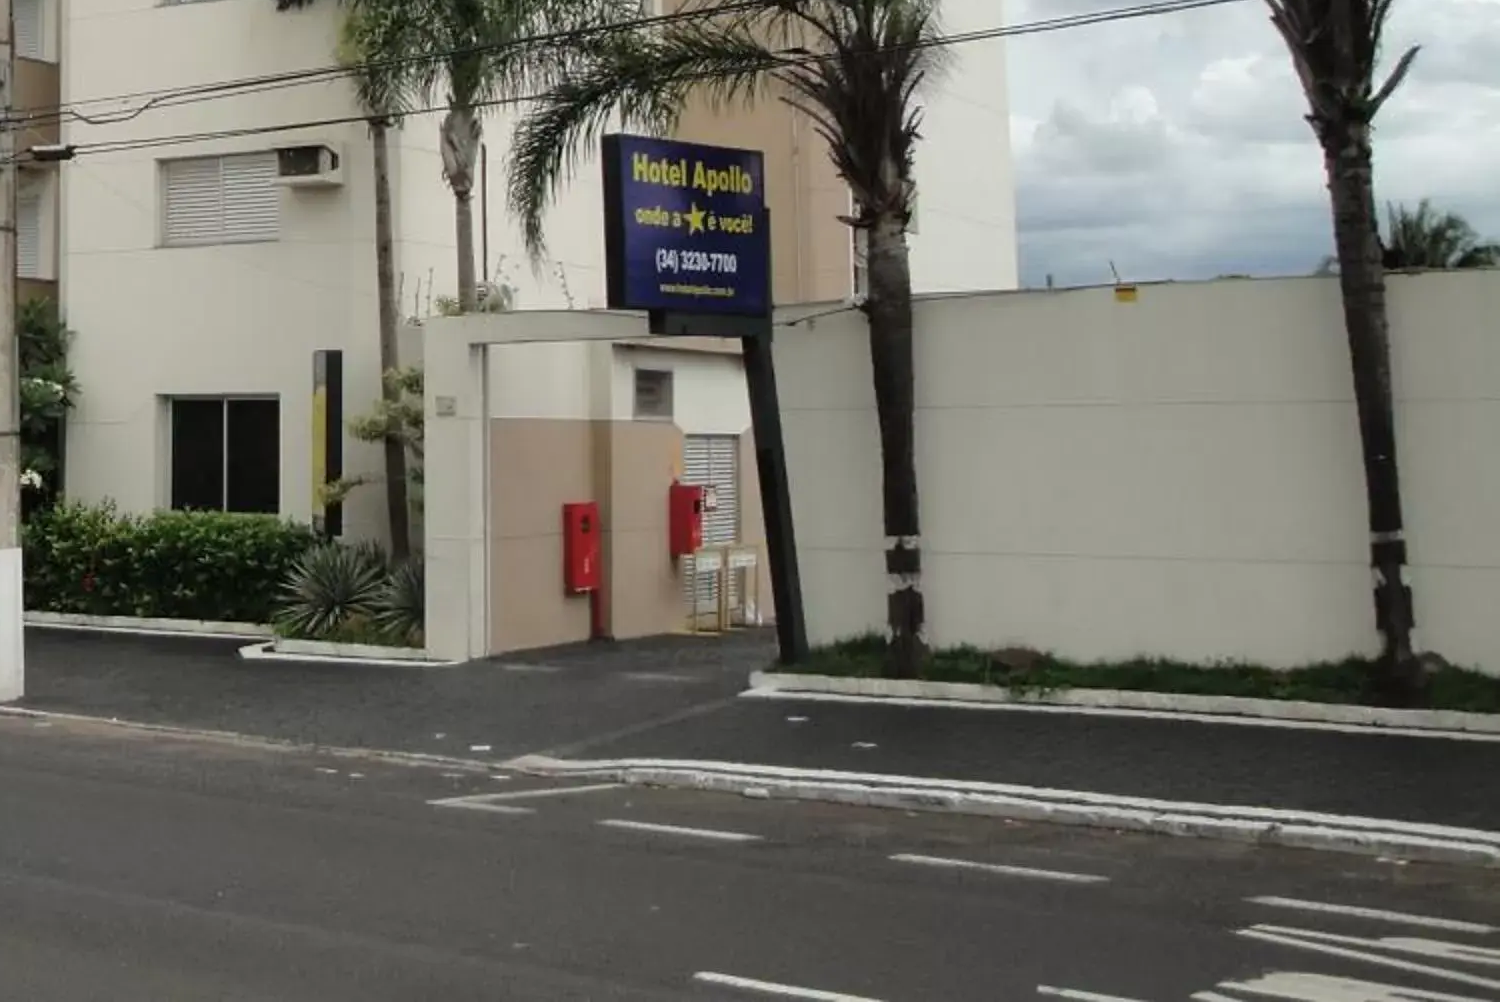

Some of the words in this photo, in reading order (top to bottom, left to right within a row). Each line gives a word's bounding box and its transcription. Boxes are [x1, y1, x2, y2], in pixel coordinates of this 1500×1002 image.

[632, 151, 687, 186] Hotel
[692, 160, 753, 196] Apollo
[655, 248, 679, 274] (34)
